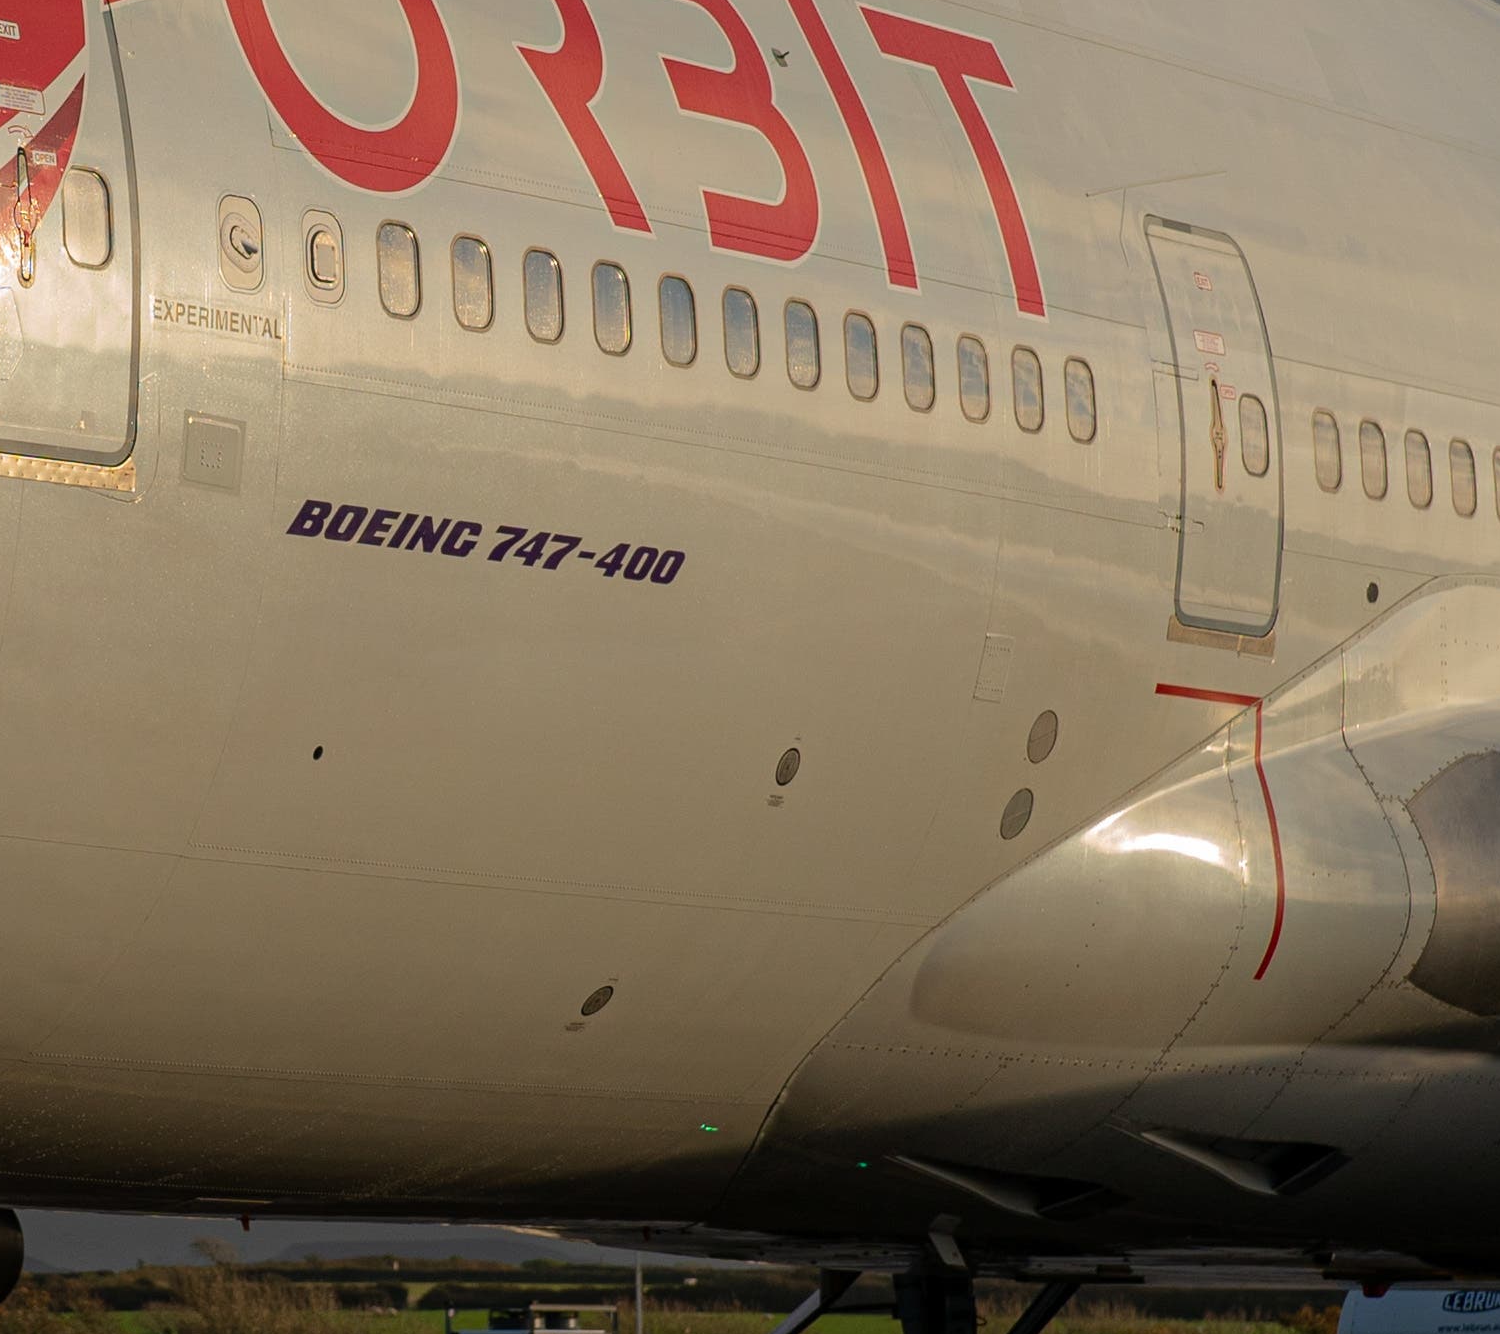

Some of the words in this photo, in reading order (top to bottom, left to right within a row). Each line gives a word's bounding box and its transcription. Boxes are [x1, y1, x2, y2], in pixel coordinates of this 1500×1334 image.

[35, 151, 55, 164] OPEN
[153, 299, 282, 340] EXPERIMENTAL
[286, 499, 483, 558] BOEING
[486, 525, 686, 584] 747-400
